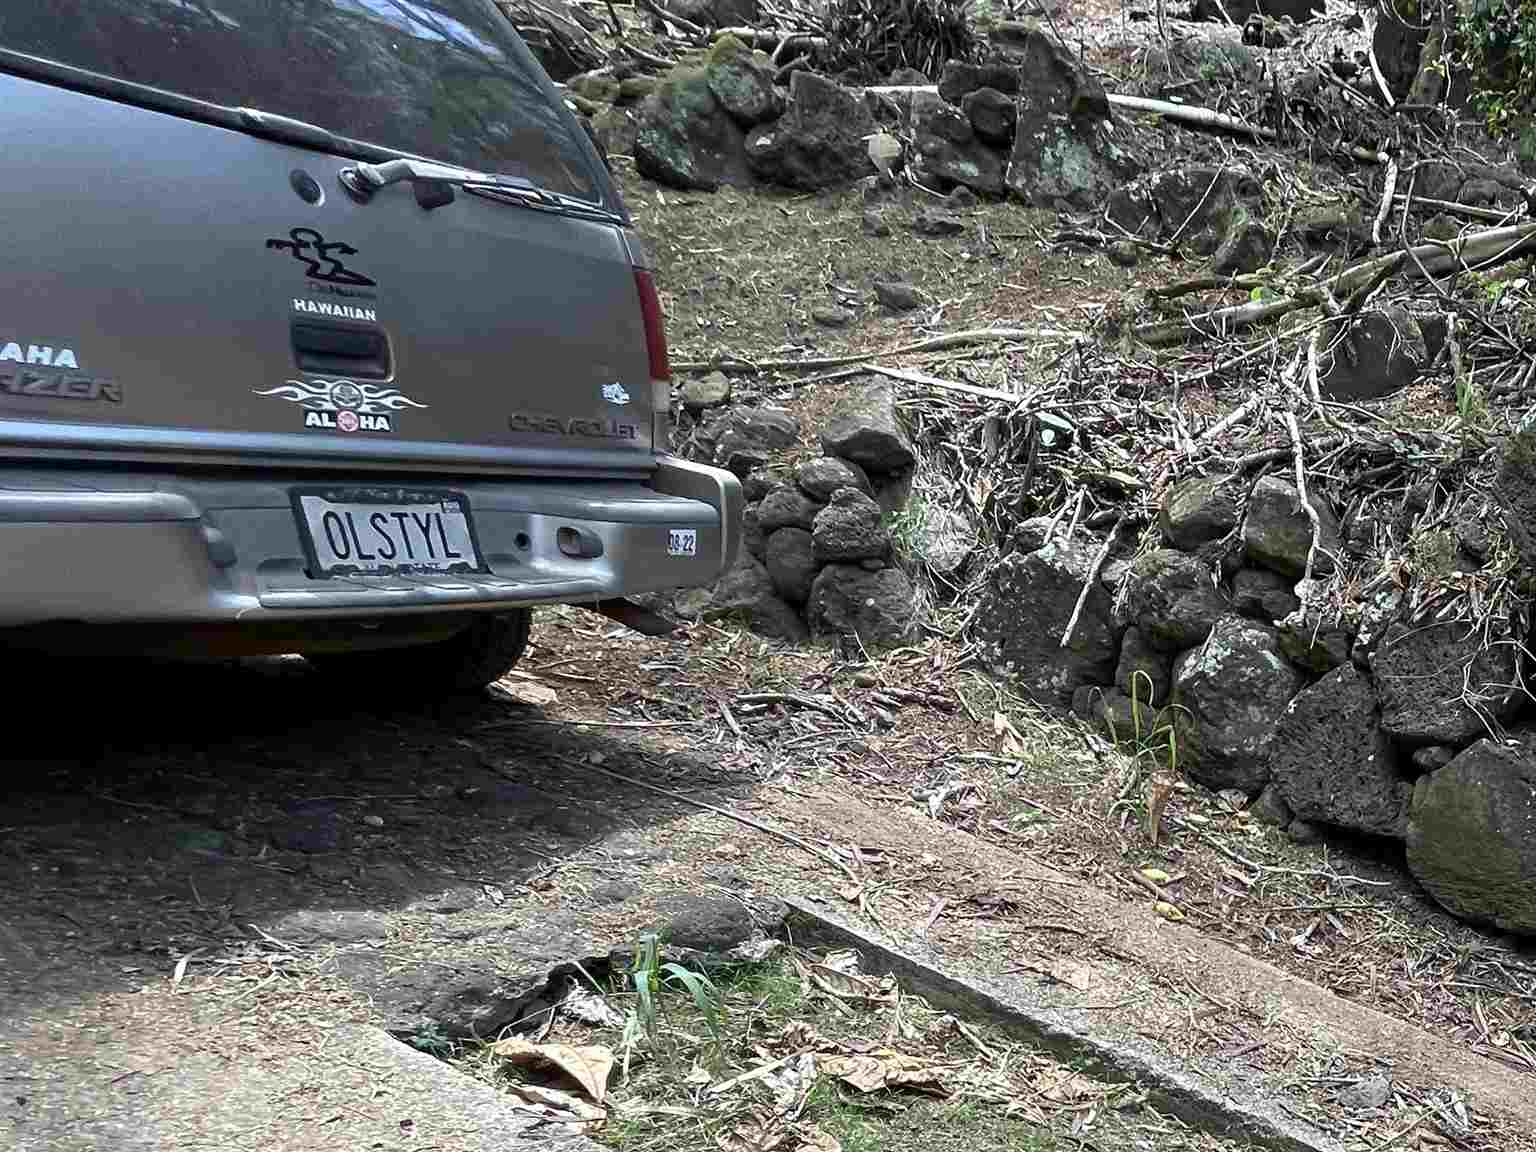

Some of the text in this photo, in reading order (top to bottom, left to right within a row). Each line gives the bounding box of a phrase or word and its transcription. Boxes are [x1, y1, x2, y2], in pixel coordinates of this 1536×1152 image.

[293, 298, 376, 321] HAWAIIAN
[305, 410, 391, 432] ALOHA
[323, 511, 461, 560] OLSTYL
